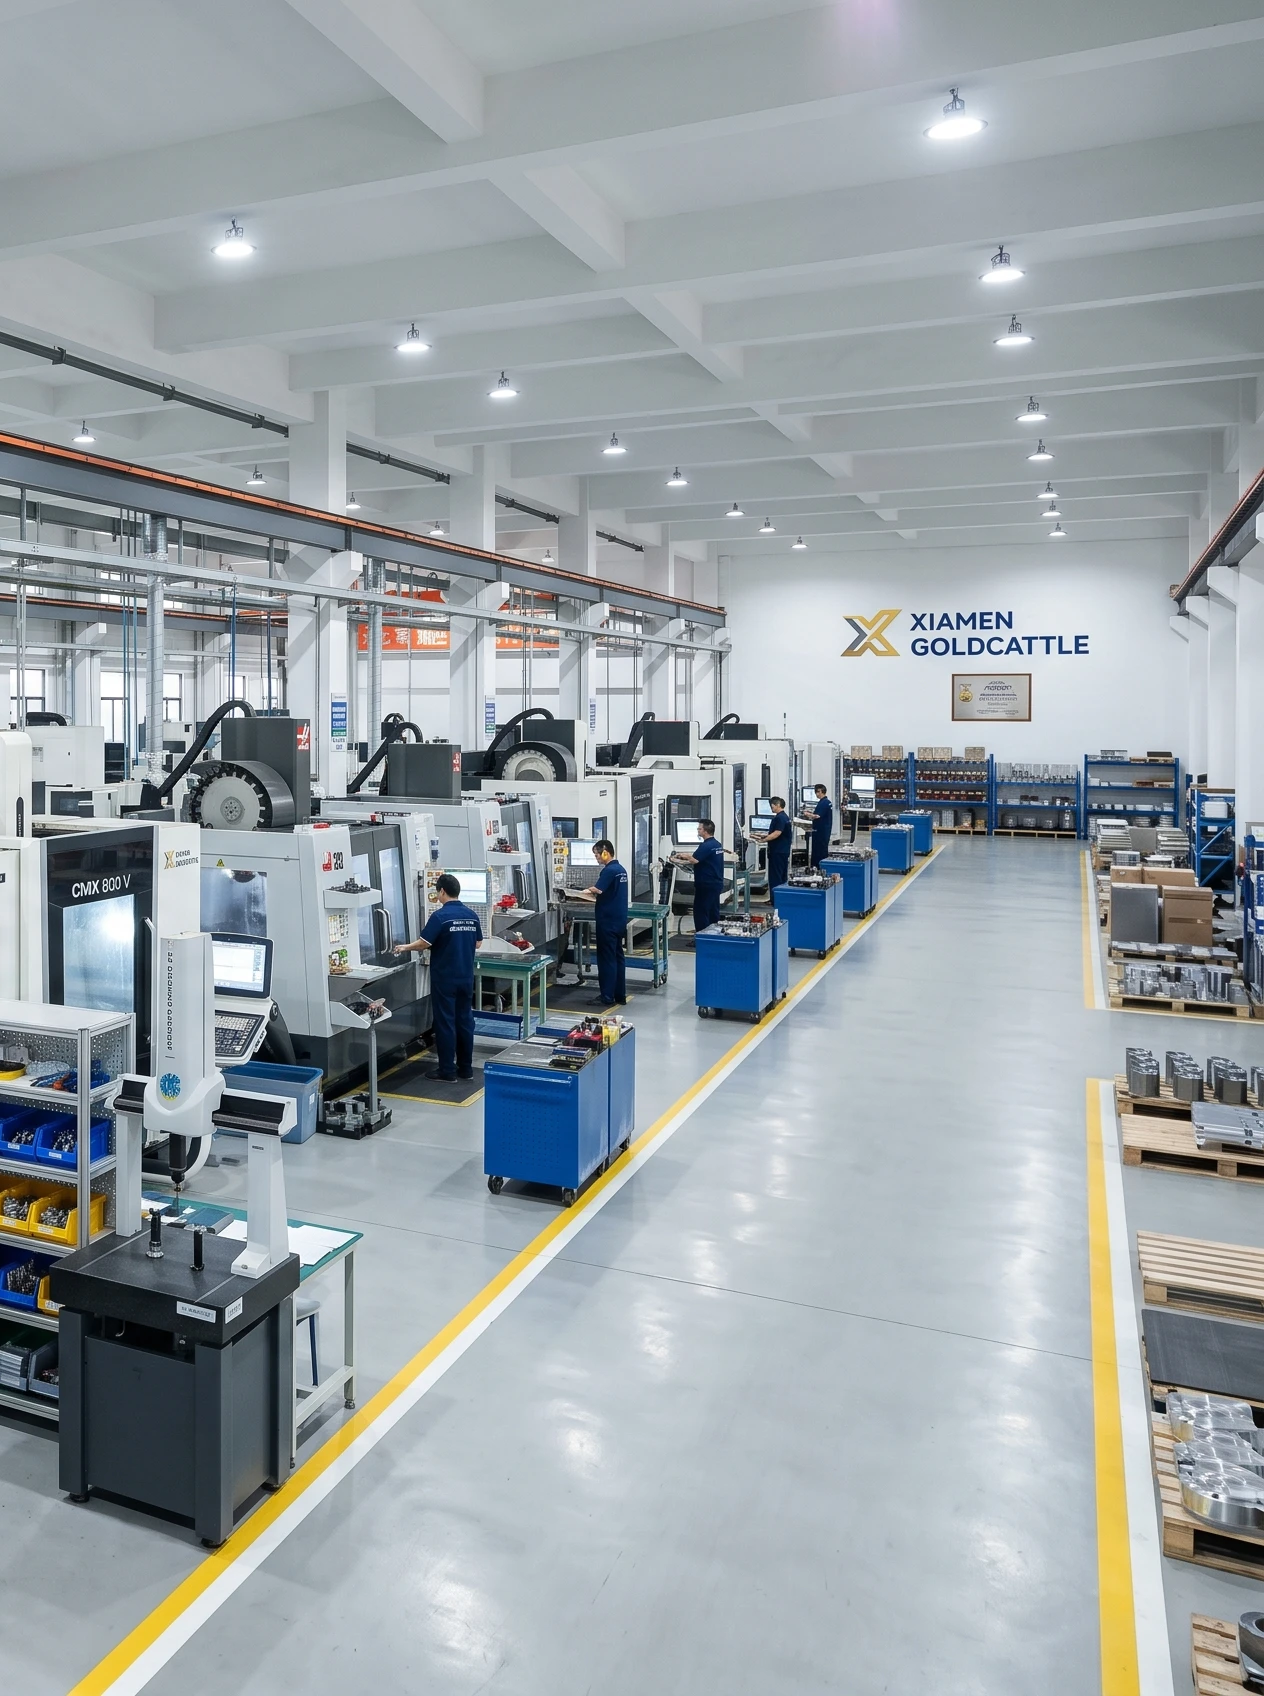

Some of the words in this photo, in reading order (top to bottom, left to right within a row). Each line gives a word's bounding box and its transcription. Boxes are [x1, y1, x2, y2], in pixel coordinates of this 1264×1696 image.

[910, 611, 1013, 631] XIAMEN
[910, 635, 1089, 656] GOLDCATTLE
[72, 881, 100, 898] CMX
[123, 874, 132, 889] V
